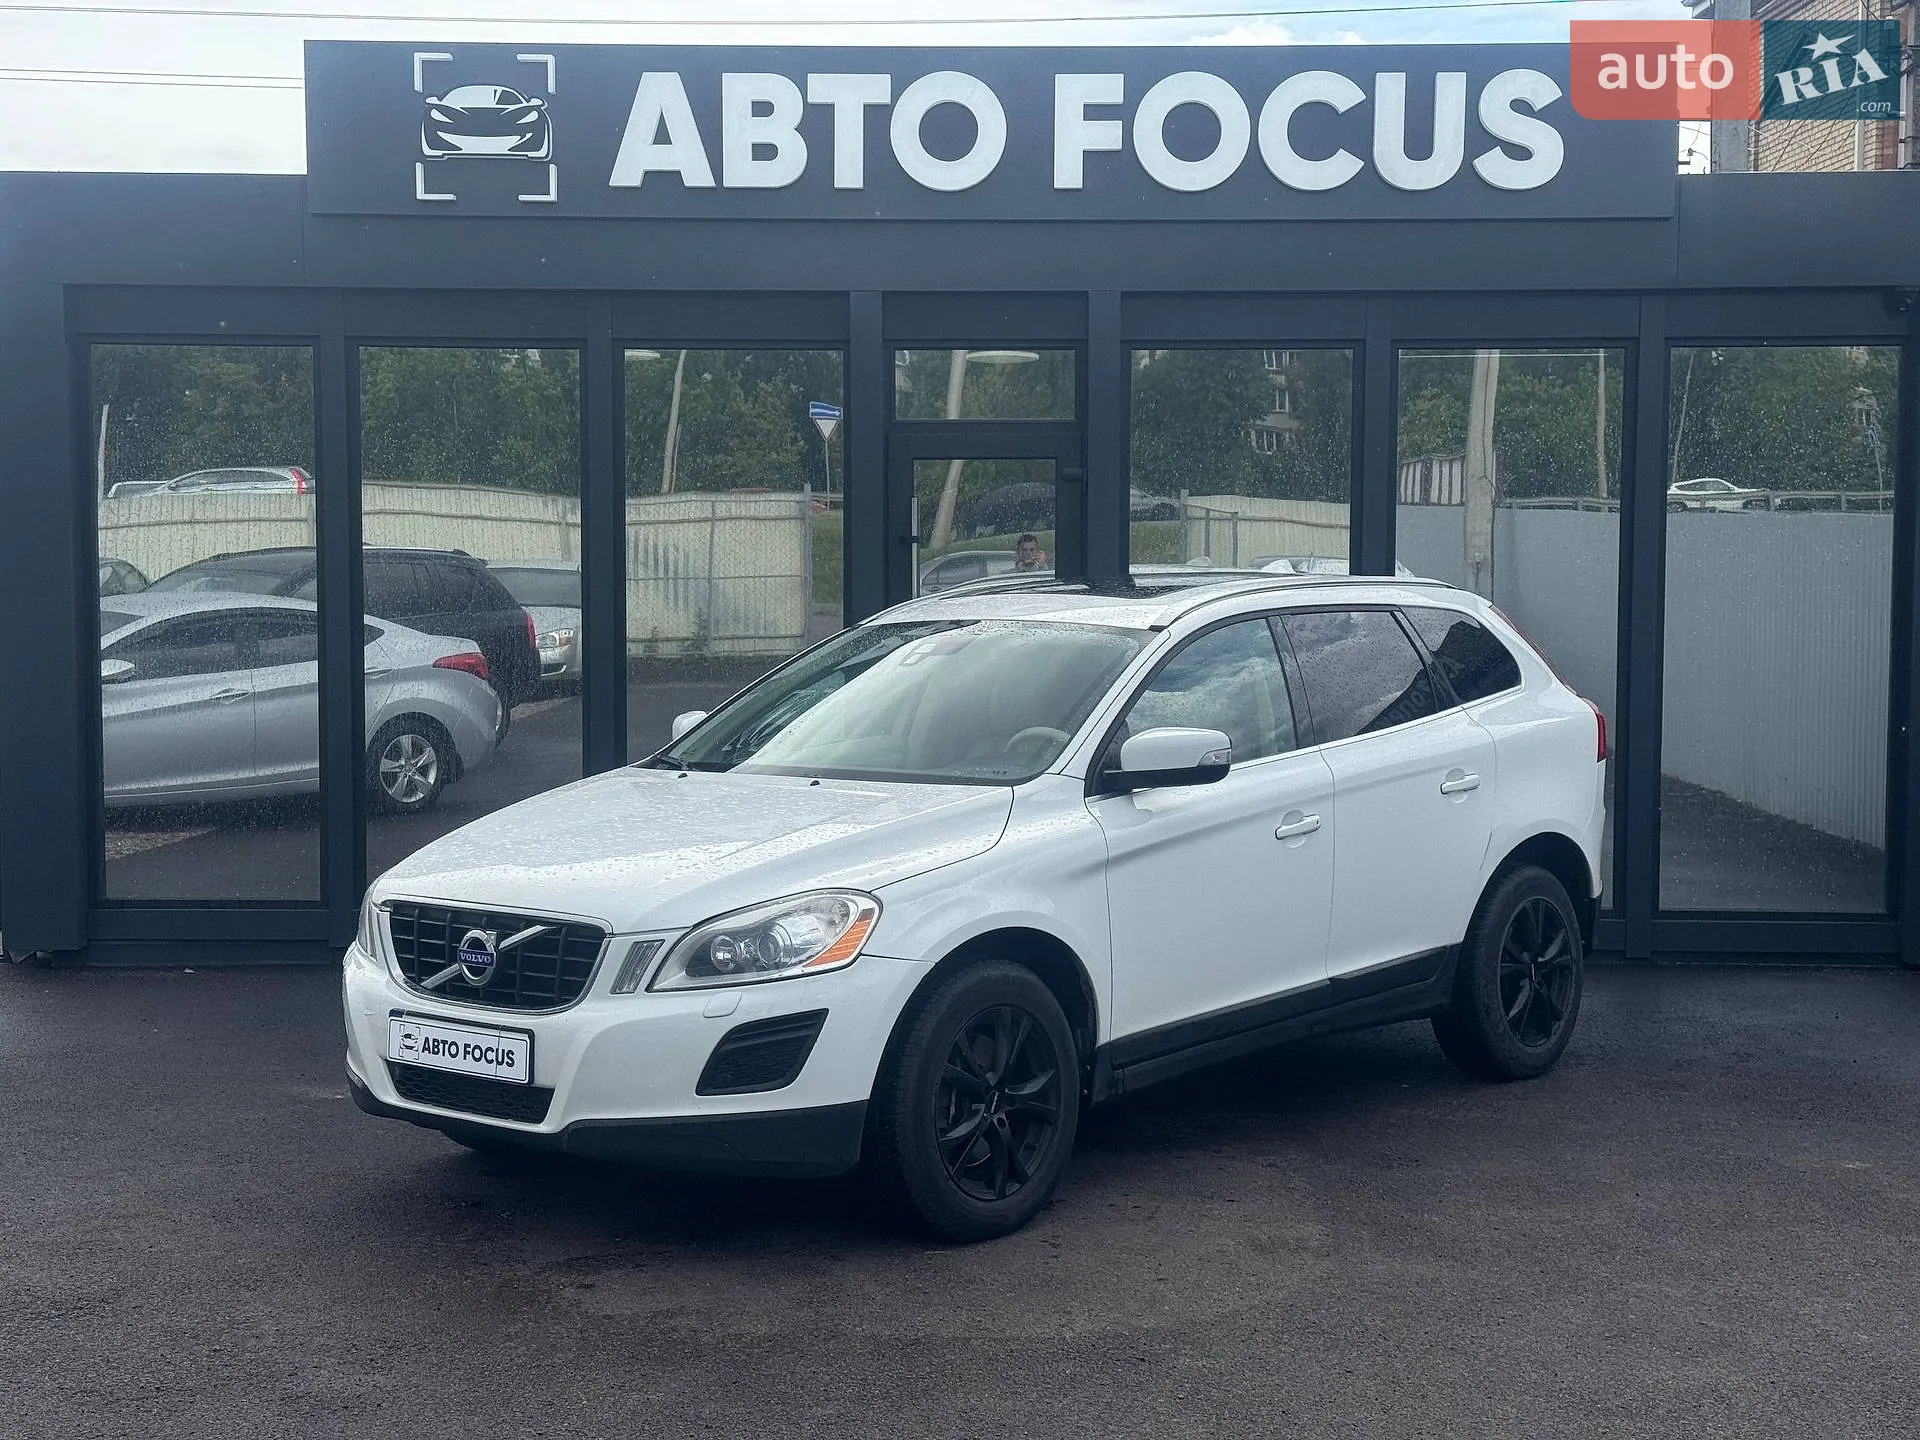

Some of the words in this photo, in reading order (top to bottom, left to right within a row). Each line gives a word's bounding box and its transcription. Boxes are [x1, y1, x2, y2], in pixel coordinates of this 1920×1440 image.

[1053, 68, 1564, 192] FOCUS
[459, 952, 492, 963] VOLVO
[463, 1044, 515, 1067] FOCUS
